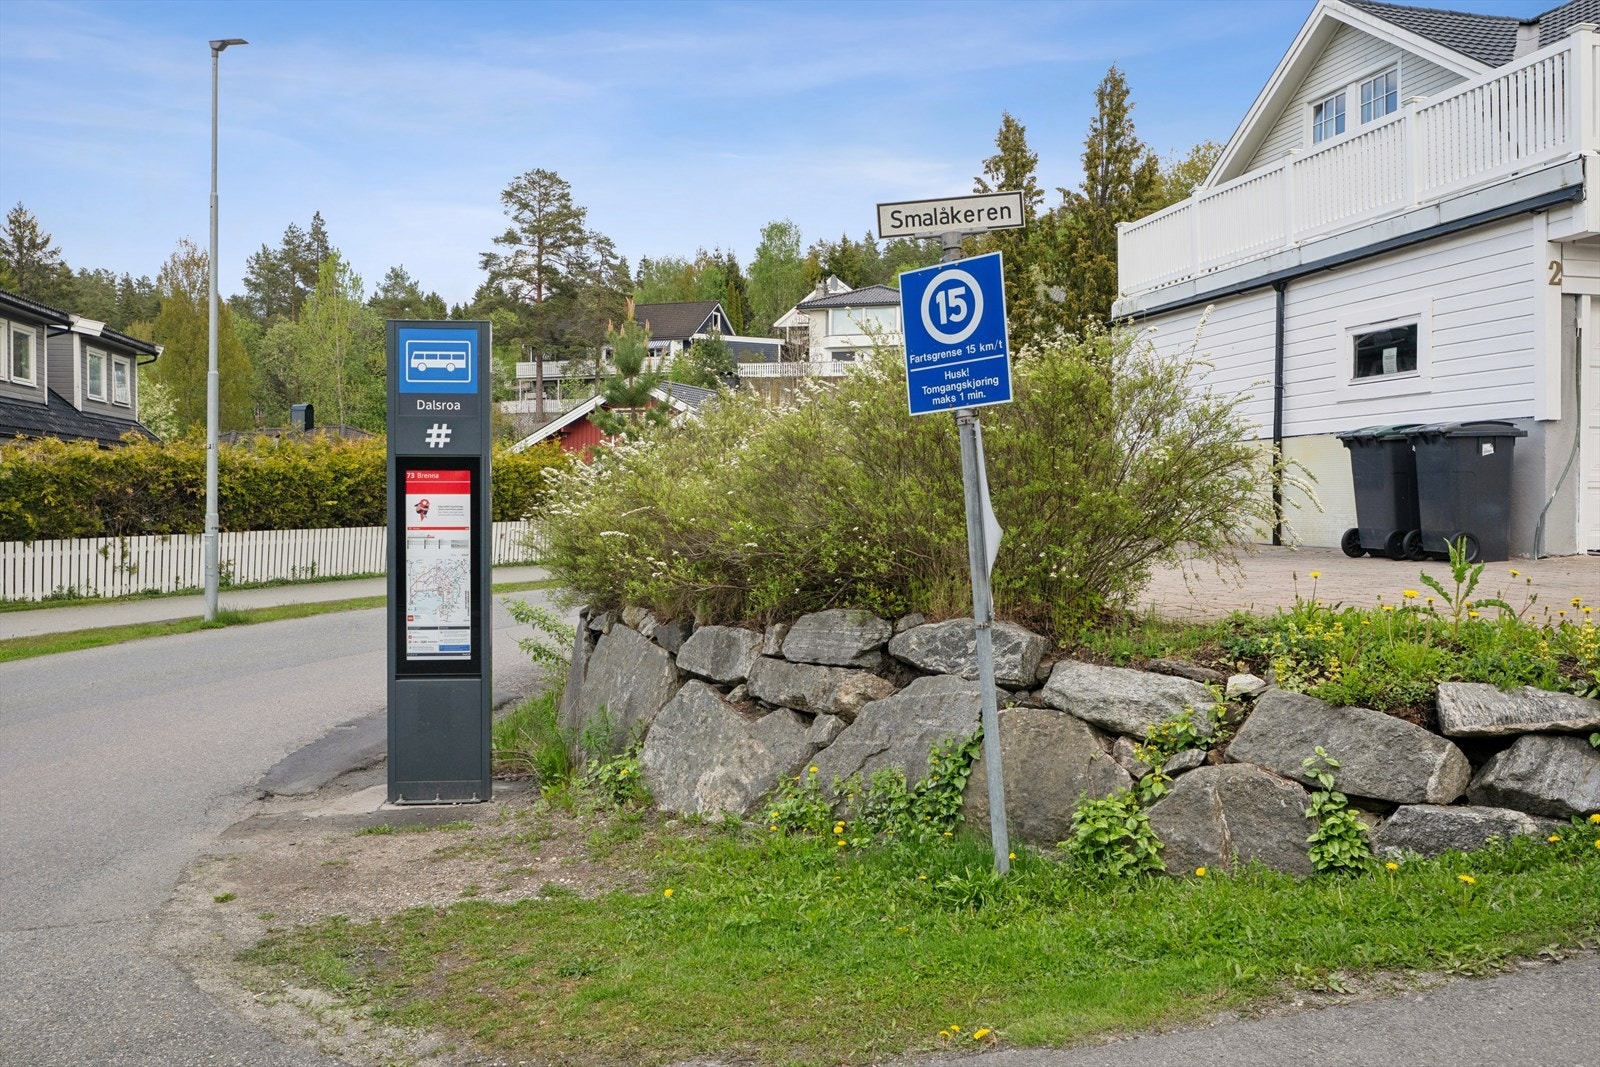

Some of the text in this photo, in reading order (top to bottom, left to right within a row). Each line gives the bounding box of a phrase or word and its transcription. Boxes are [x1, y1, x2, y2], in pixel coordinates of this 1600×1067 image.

[890, 206, 1012, 229] Smalåkeren
[1548, 260, 1562, 286] 2
[935, 286, 967, 326] 15
[909, 339, 1004, 364] Fartsgrense 15 km/t
[944, 367, 970, 380] Husk!
[921, 376, 1000, 395] Tomgangskjøring
[416, 399, 462, 411] Dalsroa
[932, 390, 987, 406] maks 1 min.
